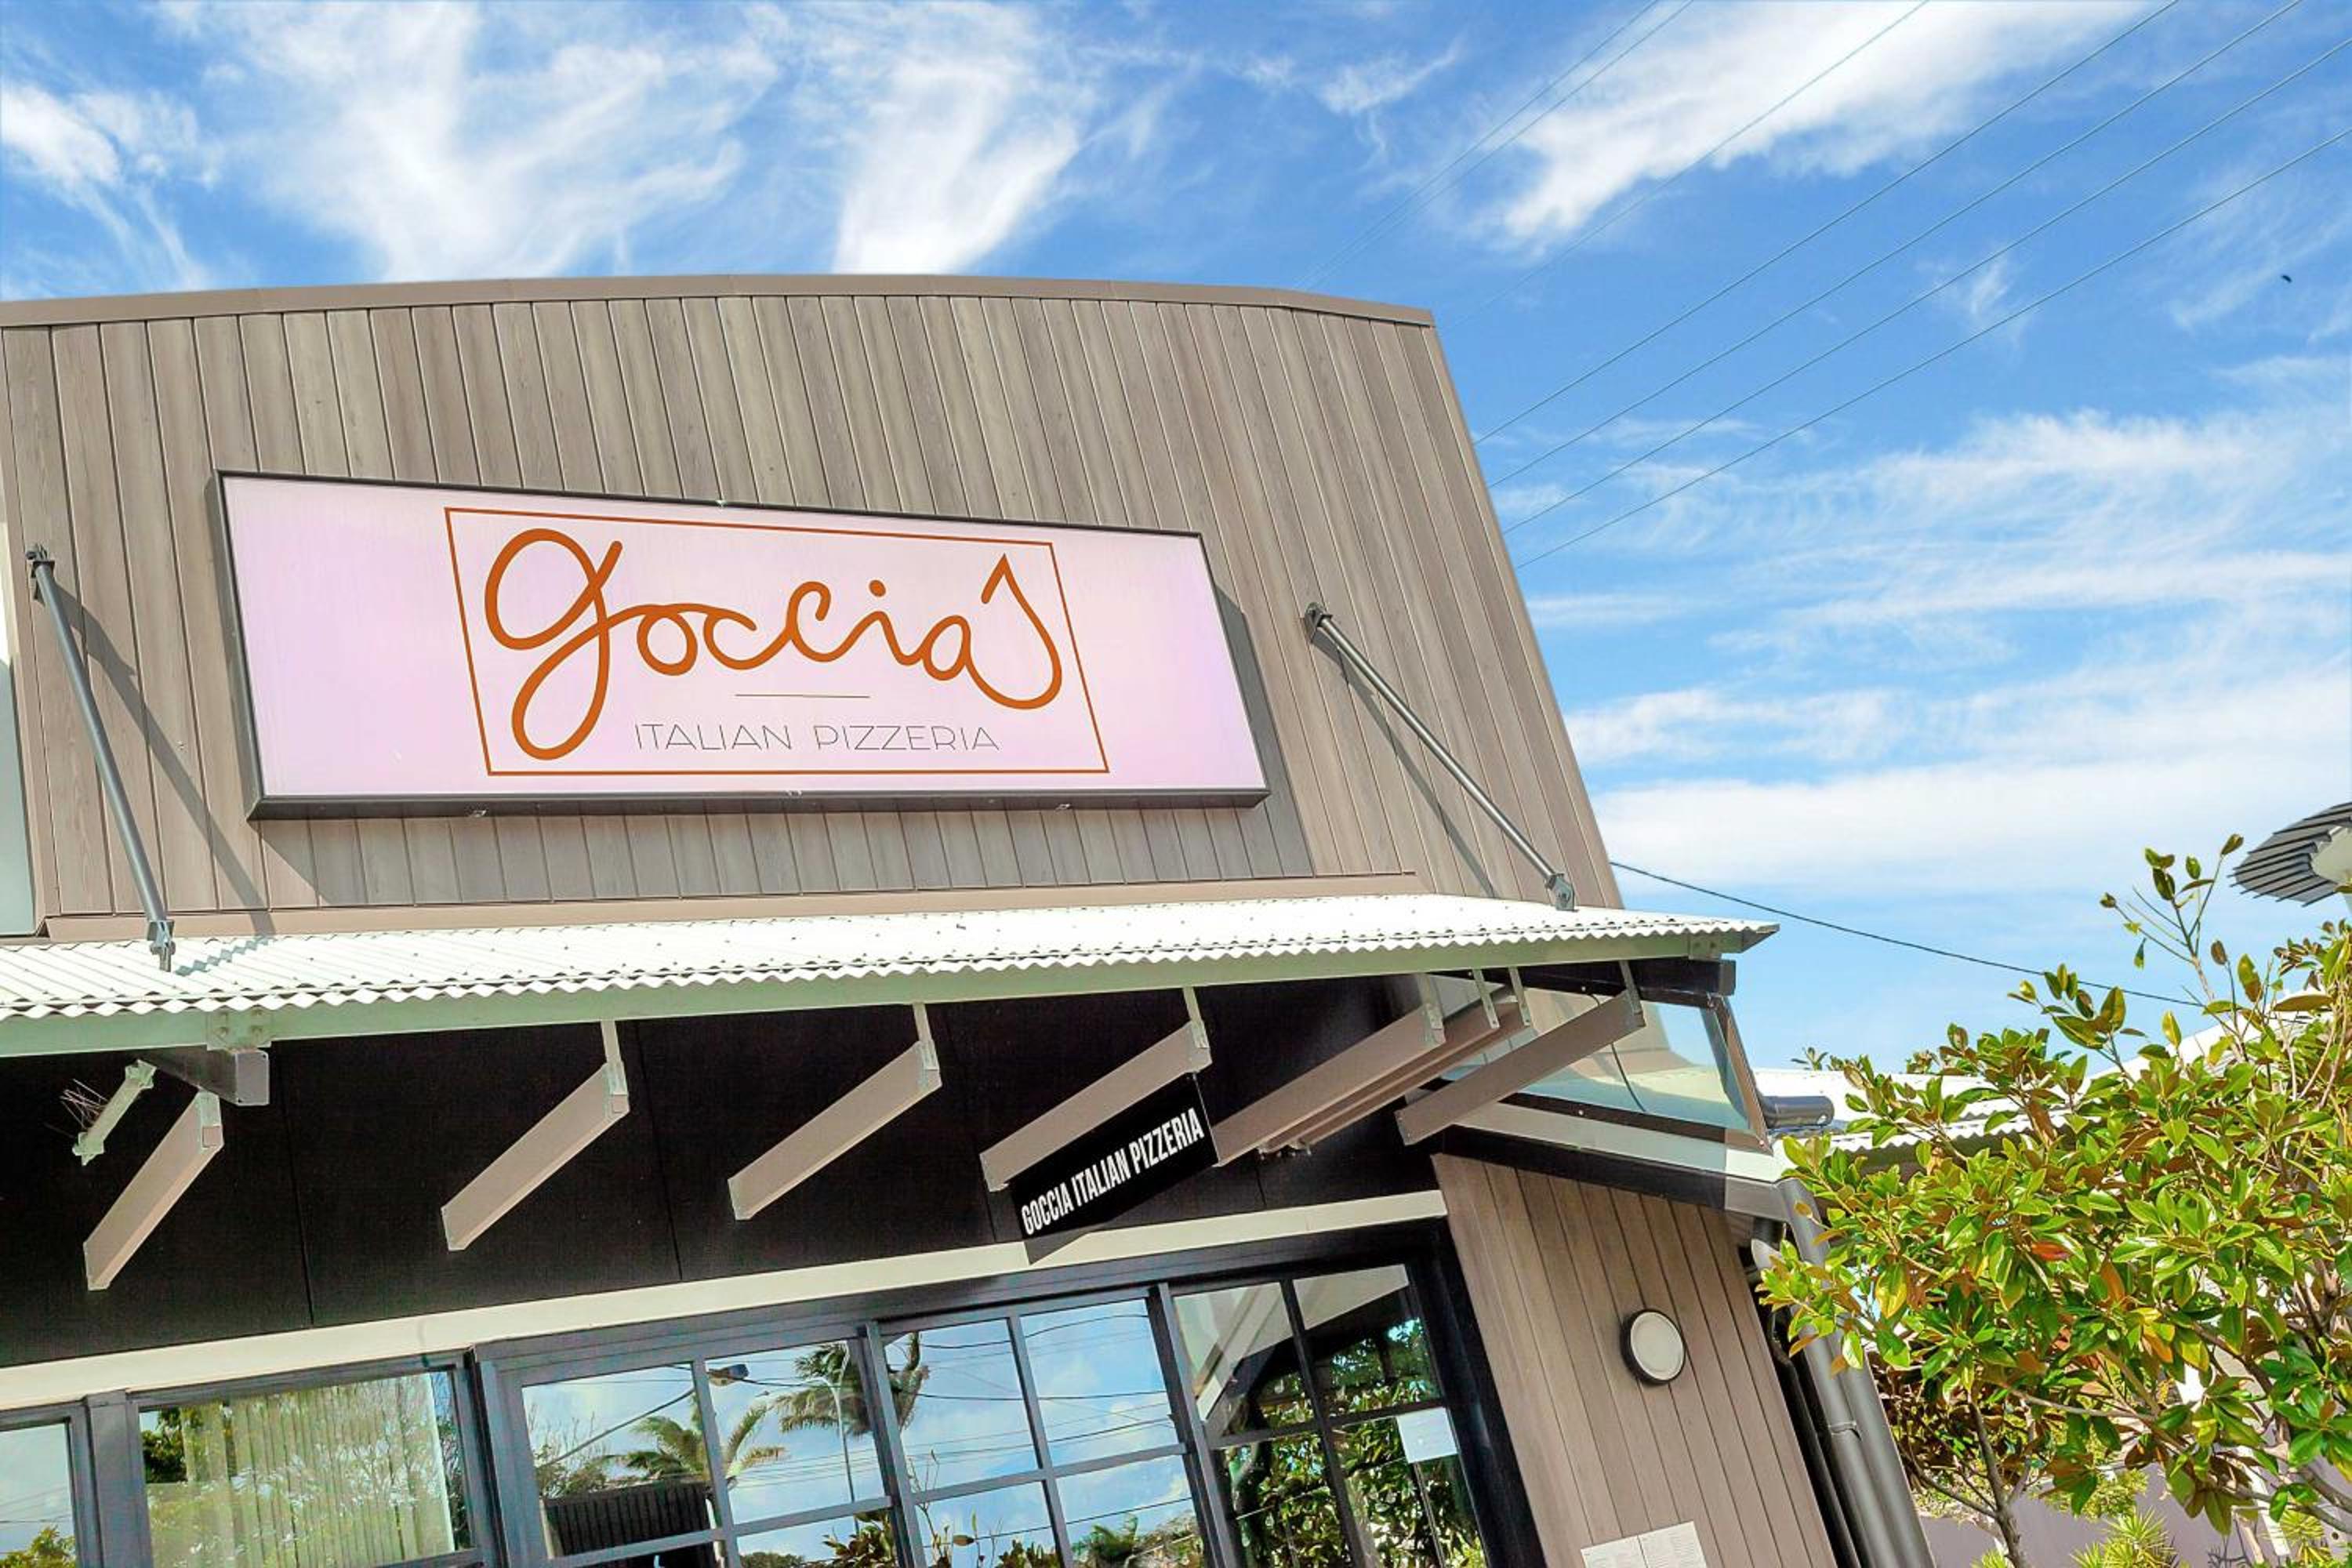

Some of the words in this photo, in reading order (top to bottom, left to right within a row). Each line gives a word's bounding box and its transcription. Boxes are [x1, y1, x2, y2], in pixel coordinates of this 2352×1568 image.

[634, 724, 792, 750] ITALIAN
[815, 725, 1000, 750] PIZZERIA
[1021, 1184, 1074, 1236] GOCCIA
[1071, 1148, 1131, 1207] ITALIAN
[1129, 1107, 1205, 1174] PIZZERIA
